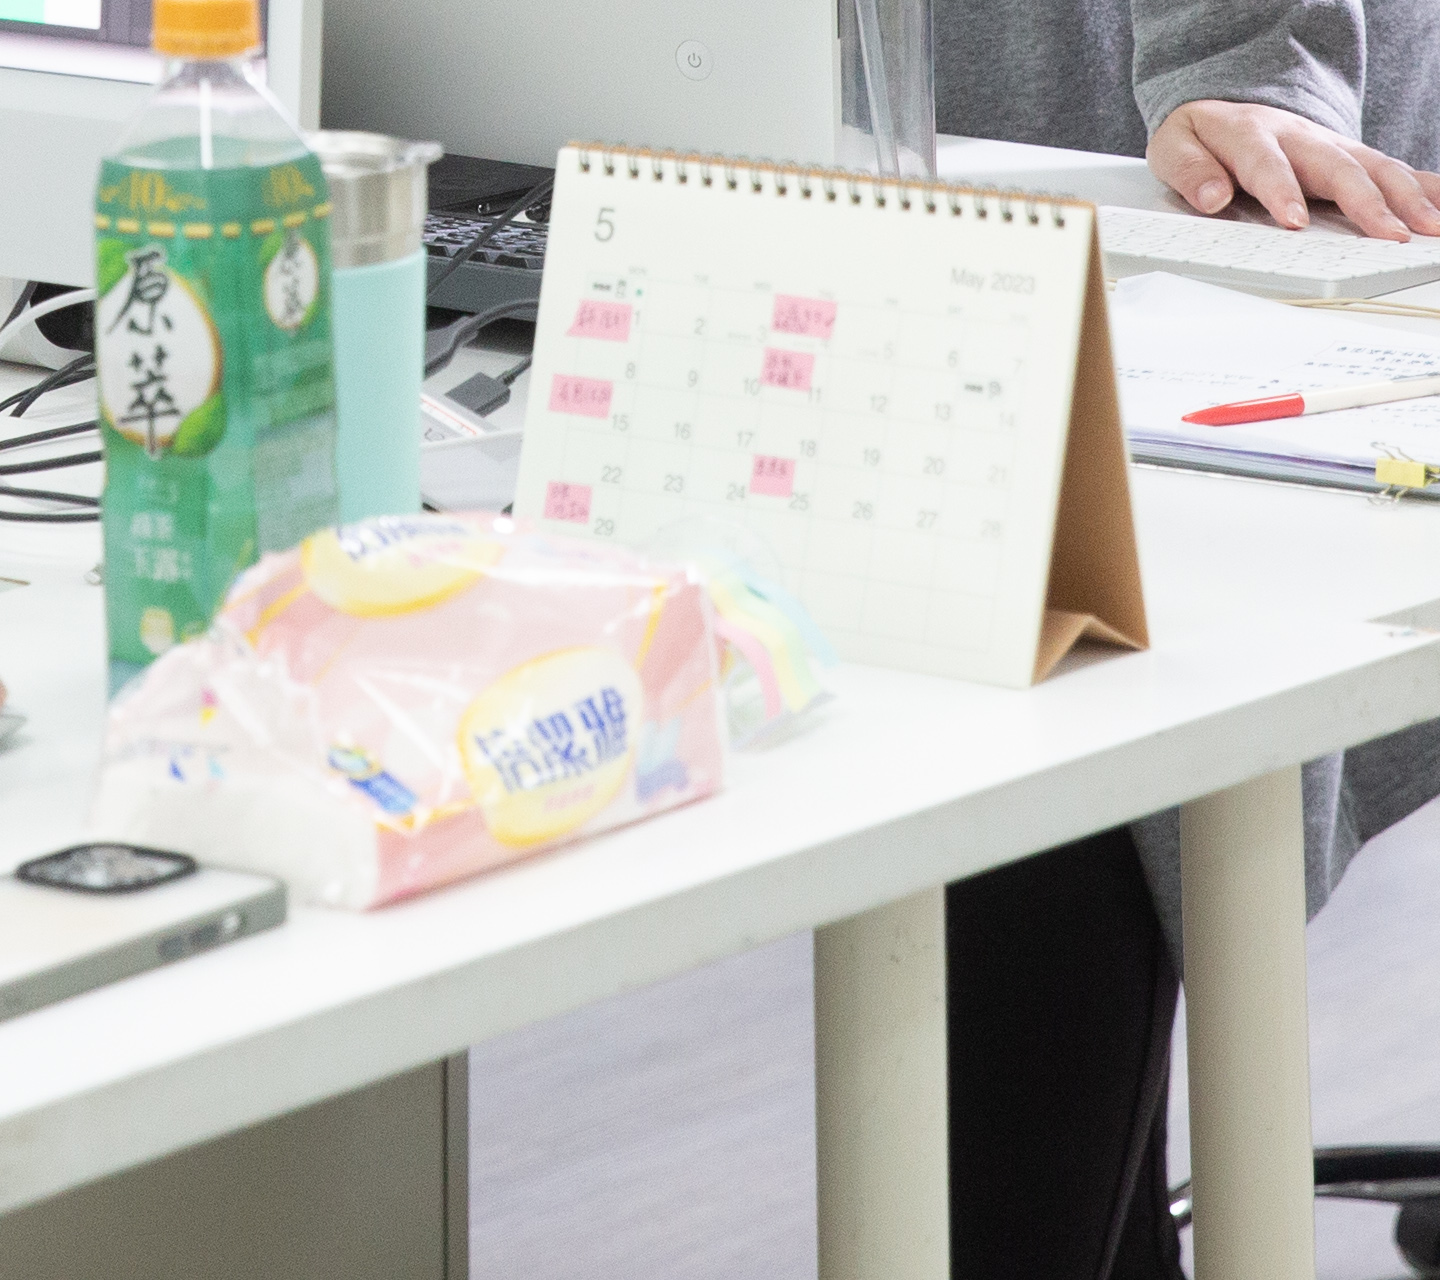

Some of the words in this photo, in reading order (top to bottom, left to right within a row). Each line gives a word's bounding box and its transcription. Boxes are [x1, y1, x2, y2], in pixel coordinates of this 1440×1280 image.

[593, 206, 616, 243] 5
[950, 266, 986, 292] May
[989, 270, 1037, 296] 2023
[105, 246, 183, 461] 原萃
[693, 317, 708, 337] 2
[755, 325, 769, 344] 3
[883, 341, 896, 360] 5
[946, 350, 961, 369] 6
[623, 361, 638, 380] 8
[686, 368, 700, 389] 9
[742, 376, 762, 397] 10
[869, 394, 890, 414] 12
[932, 402, 954, 423] 13
[610, 412, 631, 433] 15
[673, 420, 694, 441] 16
[735, 429, 755, 449] 17
[798, 437, 819, 458] 18
[861, 446, 882, 468] 19
[922, 455, 947, 477] 20
[986, 464, 1008, 485] 21
[592, 517, 617, 538] 29
[600, 464, 624, 485] 22
[662, 473, 686, 495] 23
[725, 482, 748, 503] 24
[787, 491, 811, 512] 25
[851, 500, 875, 521] 26
[915, 509, 939, 530] 27
[979, 518, 1004, 539] 28
